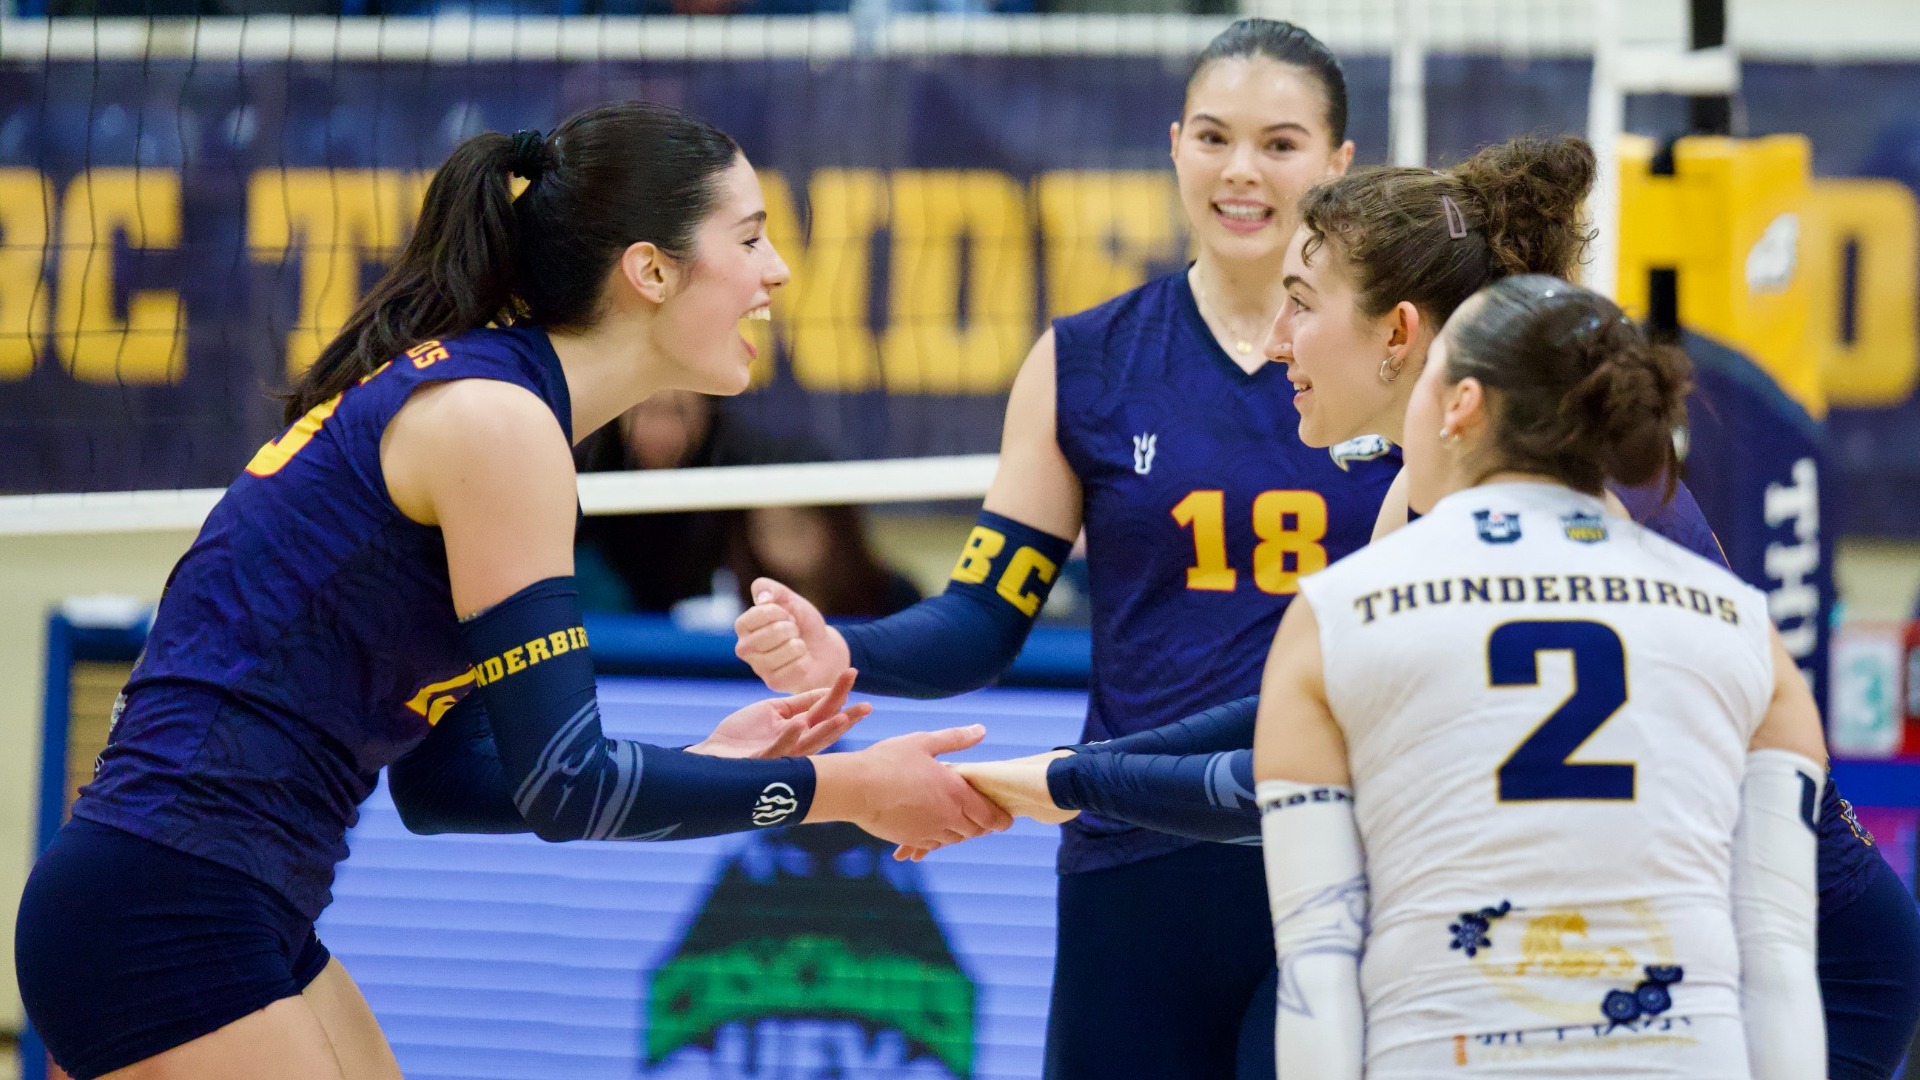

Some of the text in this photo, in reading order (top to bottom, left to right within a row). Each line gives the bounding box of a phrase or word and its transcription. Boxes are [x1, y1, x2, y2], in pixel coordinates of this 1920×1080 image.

[950, 525, 1058, 618] BC
[1171, 489, 1328, 595] 18
[1354, 574, 1740, 626] THUNDERBIRDS
[1486, 618, 1638, 804] 2
